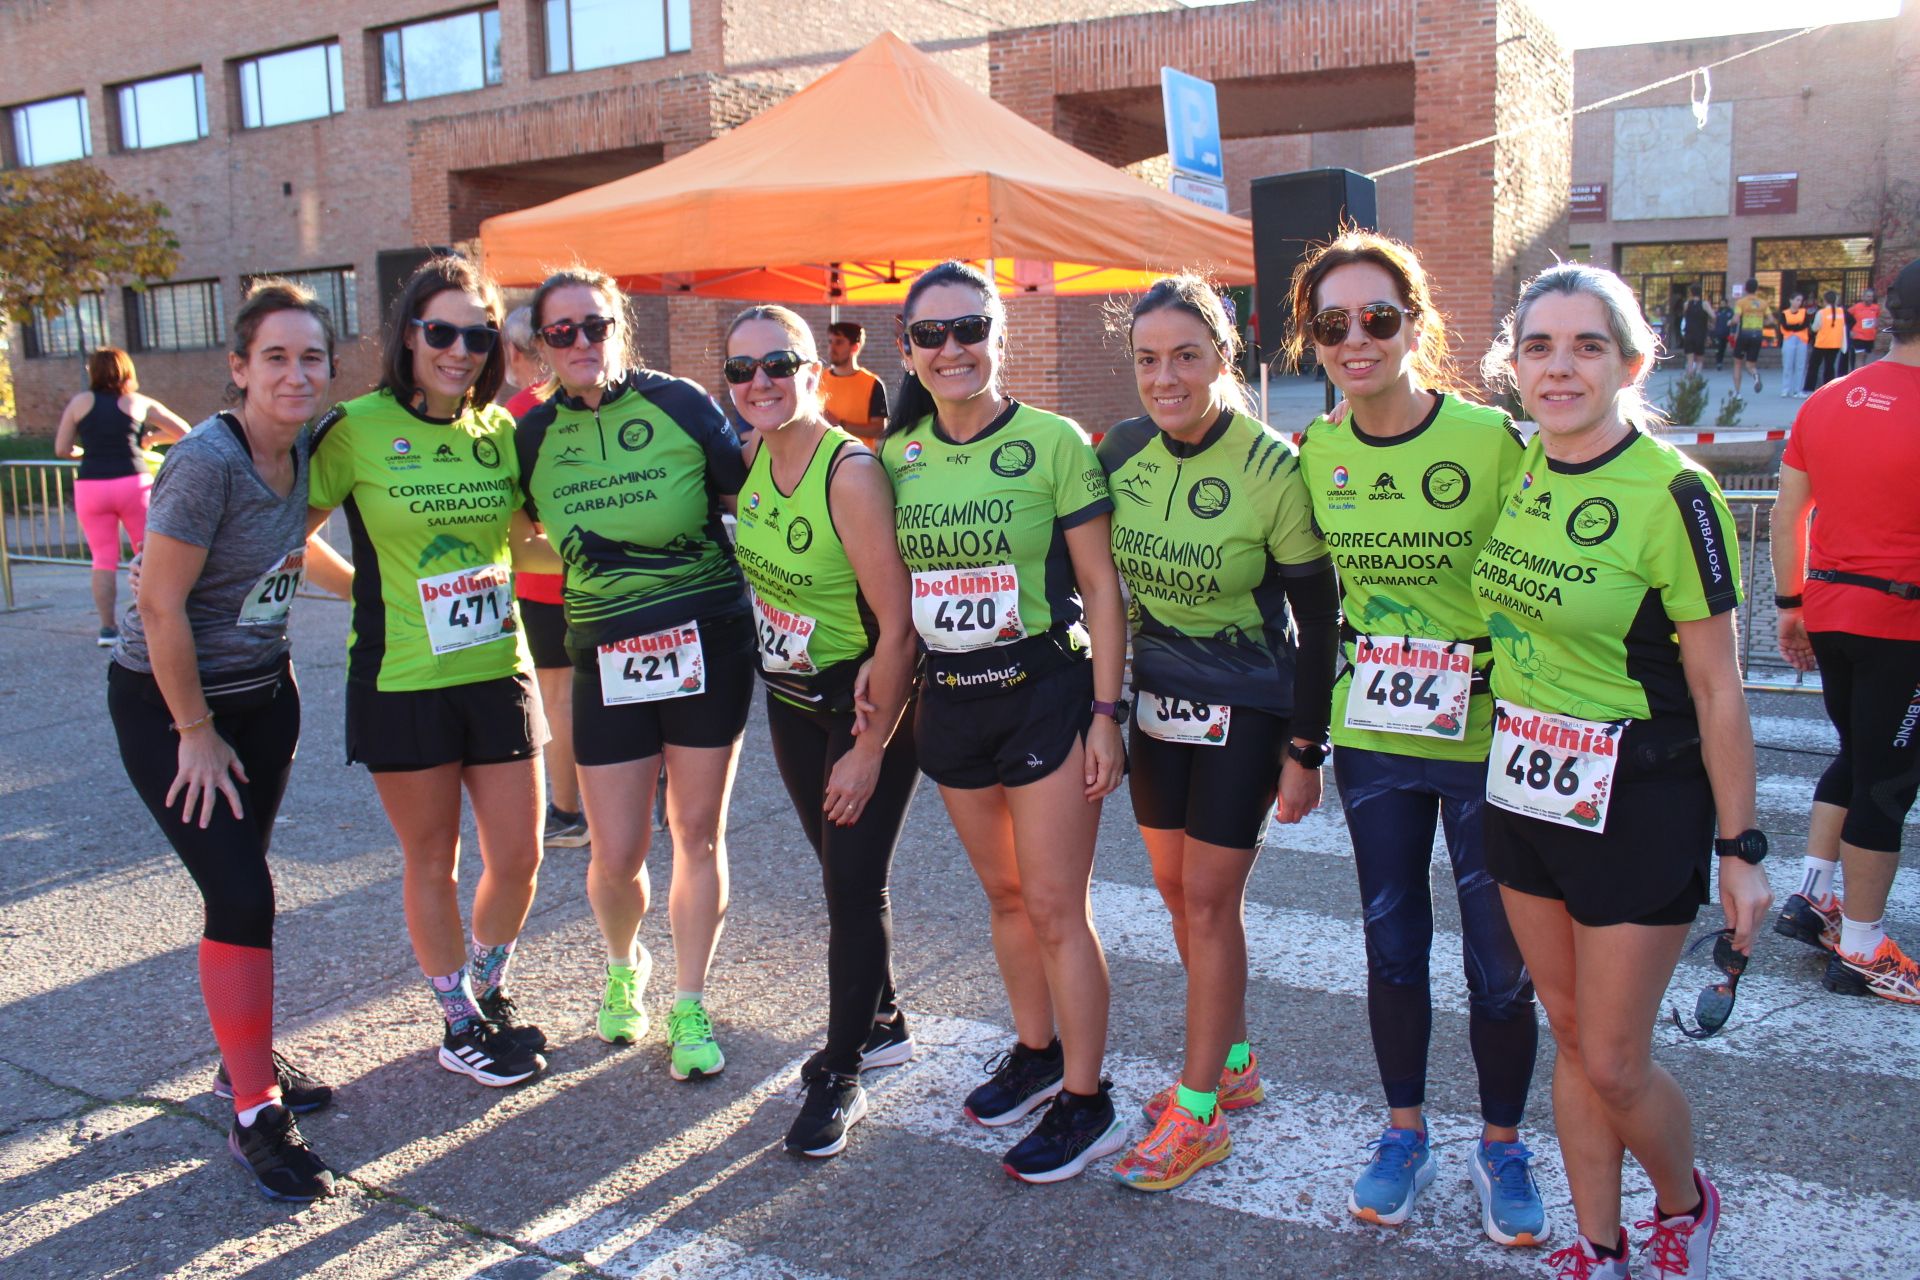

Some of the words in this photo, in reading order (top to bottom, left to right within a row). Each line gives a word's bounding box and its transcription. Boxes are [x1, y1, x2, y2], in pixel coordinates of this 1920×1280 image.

[553, 467, 668, 499] CORRECAMINOS
[1368, 492, 1405, 501] austral
[409, 496, 507, 514] CARBAJOSA
[564, 489, 658, 515] CARBAJOSA
[427, 514, 498, 527] SALAMANCA
[1324, 531, 1473, 549] CORRECAMINOS
[1692, 499, 1722, 583] CARBAJOSA
[1337, 554, 1453, 569] CARBAJOSA
[258, 571, 300, 604] 201
[421, 569, 508, 602] bedunia
[915, 571, 1016, 598] bedunia
[1353, 575, 1438, 586] SALAMANCA
[1473, 558, 1563, 606] CARBAJOSA
[449, 591, 499, 628] 471
[935, 598, 996, 632] 420
[1478, 586, 1544, 621] SALAMANCA
[623, 652, 680, 683] 421
[1356, 641, 1471, 674] bedunia
[936, 665, 1017, 687] Columbus
[1008, 671, 1028, 687] Trail
[1366, 669, 1440, 711] 484
[1498, 715, 1614, 757] bedunia
[1506, 744, 1579, 796] 486
